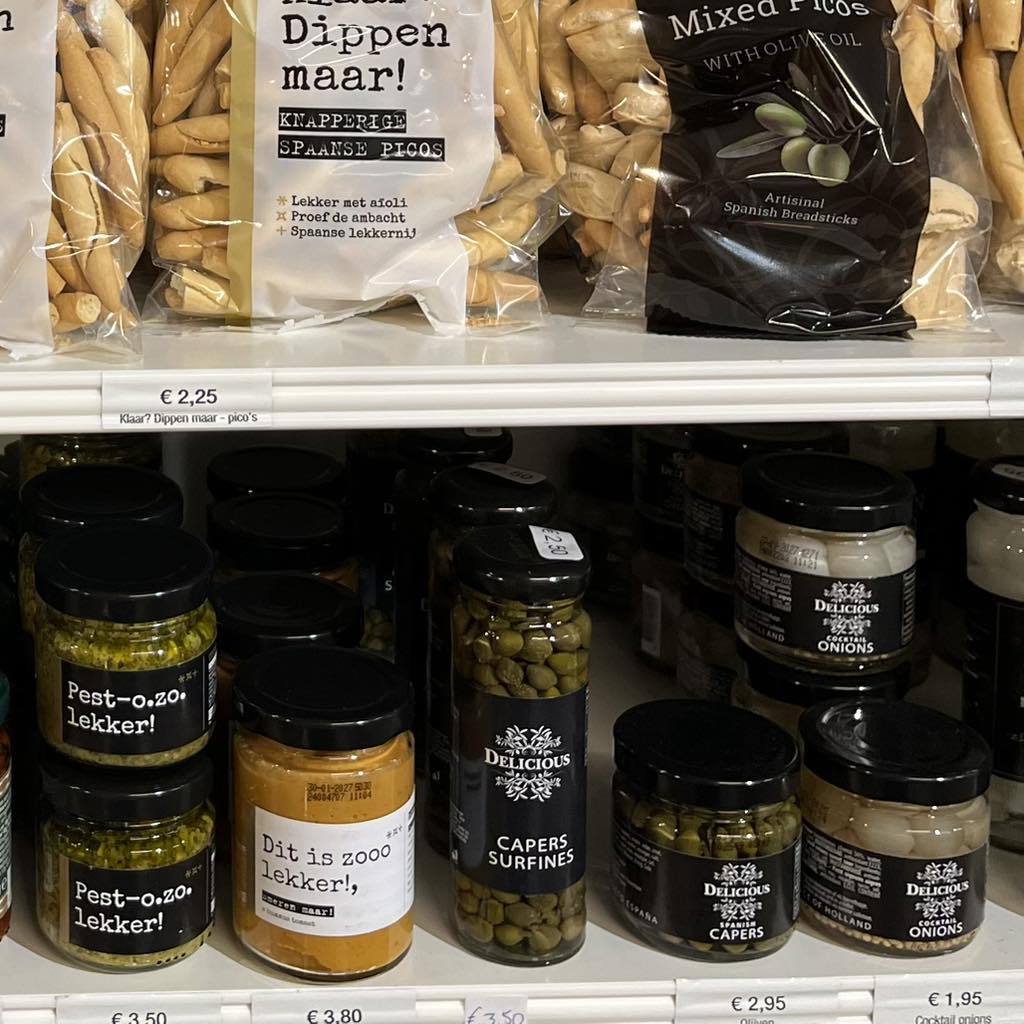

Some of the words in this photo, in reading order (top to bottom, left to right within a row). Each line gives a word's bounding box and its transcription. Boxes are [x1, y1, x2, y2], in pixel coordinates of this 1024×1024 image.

[281, 14, 450, 55] Dippen
[703, 45, 761, 72] WITH
[830, 32, 862, 47] OIL
[281, 58, 406, 92] maar!
[279, 110, 406, 130] KNAPPERIGE
[279, 140, 368, 158] SPAANSE
[379, 142, 444, 160] PICOS
[291, 195, 340, 208] Lekker
[343, 197, 367, 208] met
[291, 210, 330, 223] Proef
[332, 211, 349, 223] de
[351, 211, 406, 224] ambacht
[723, 201, 778, 219] Spanish
[780, 207, 860, 226] Breadsticks
[290, 226, 346, 239] Spaanse
[348, 226, 417, 240] lekkernij
[160, 389, 173, 405] €
[177, 388, 218, 407] 2,25
[119, 413, 151, 425] Klaar?
[154, 412, 189, 426] Dippen
[191, 414, 218, 424] maar
[227, 412, 258, 426] pico's
[814, 598, 880, 616] DELICIOUS
[817, 640, 875, 656] ONIONS
[826, 634, 867, 644] COCKTAIL
[67, 679, 187, 709] Pest-o.zo.
[66, 705, 157, 735] lekker!
[484, 746, 571, 772] DELICIOUS
[262, 833, 299, 862] Dit
[306, 847, 334, 866] is
[342, 844, 391, 867] zooo
[497, 833, 568, 853] CAPERS
[488, 848, 574, 870] SURFINES
[74, 881, 193, 909] Pest-o.zo.
[703, 882, 772, 897] DELICIOUS
[906, 880, 970, 897] DELICIOUS
[74, 906, 164, 934] lekker!
[719, 921, 757, 929] SPANISH
[824, 903, 873, 932] HOLLAND
[918, 917, 958, 928] COCKTAIL
[709, 926, 765, 941] CAPERS
[909, 922, 964, 939] ONIONS
[732, 996, 743, 1012] €
[749, 995, 787, 1013] 2,95
[929, 992, 940, 1007] €
[945, 991, 983, 1008] 1,95
[307, 1009, 319, 1024] €
[324, 1008, 363, 1024] 3,80
